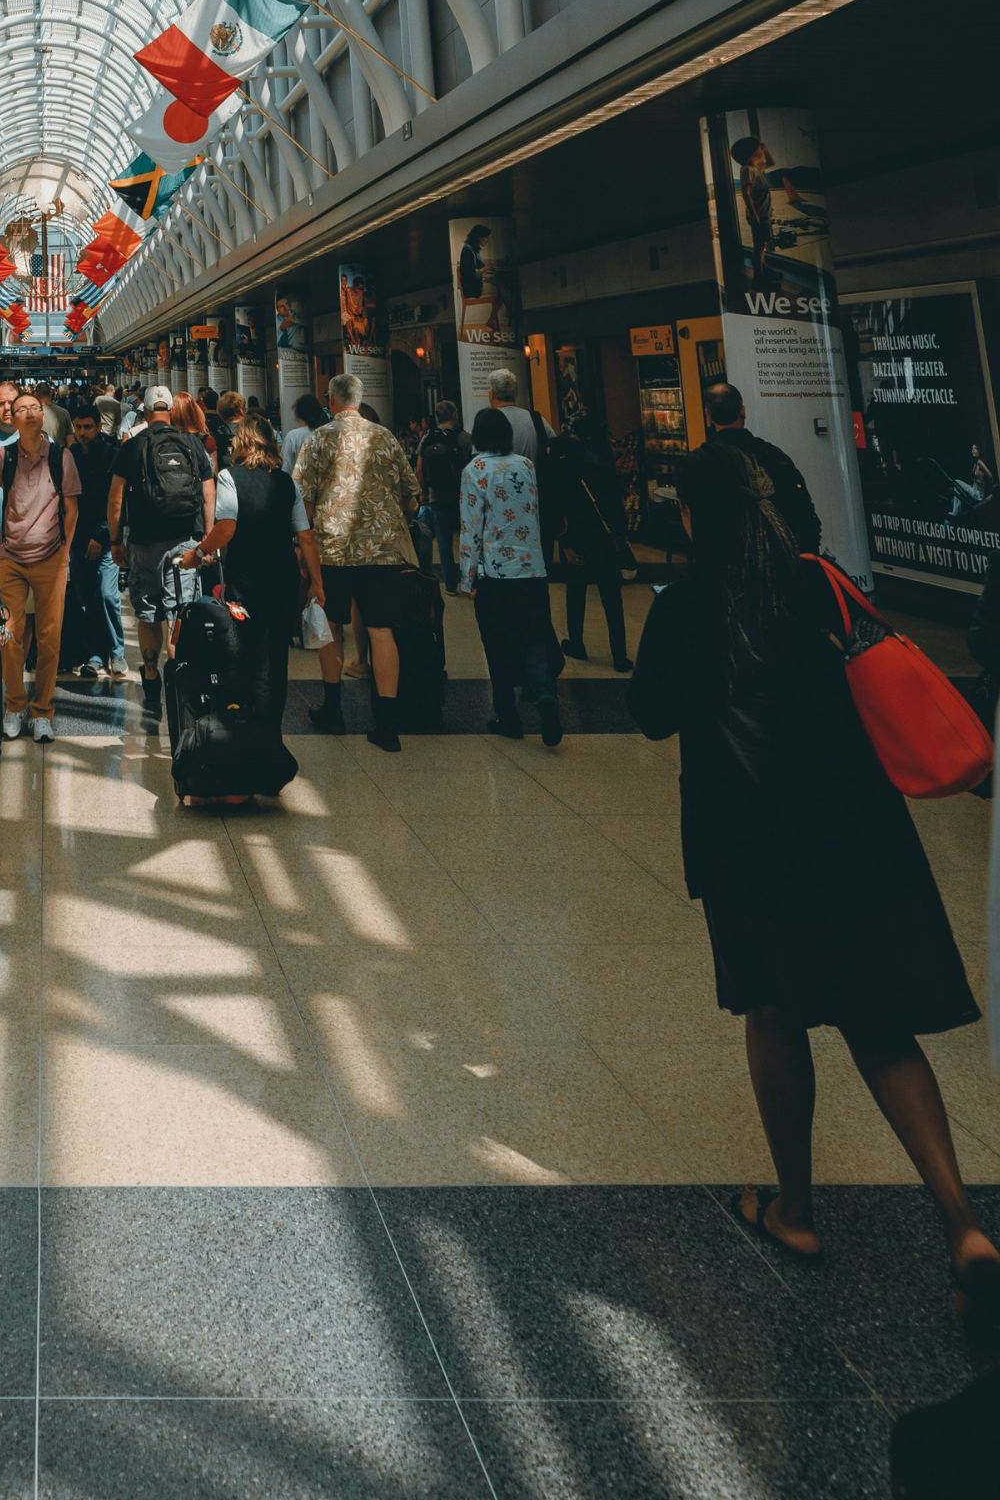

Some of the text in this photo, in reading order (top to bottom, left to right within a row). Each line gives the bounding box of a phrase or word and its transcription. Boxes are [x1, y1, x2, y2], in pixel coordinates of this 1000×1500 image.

[744, 292, 831, 314] We see
[466, 329, 516, 342] We see
[800, 338, 824, 346] lasting
[872, 334, 940, 350] THRILLING MUSIC.
[348, 344, 384, 354] We see
[788, 346, 806, 355] long
[872, 362, 948, 377] DAZZLING THEATER.
[873, 388, 958, 404] STUNNING SPECTACLE.
[872, 513, 1000, 549] NO TRIP TO CHICAGO IS COMPLETE
[874, 535, 989, 573] WITHOUT A VISIT TO LYR
